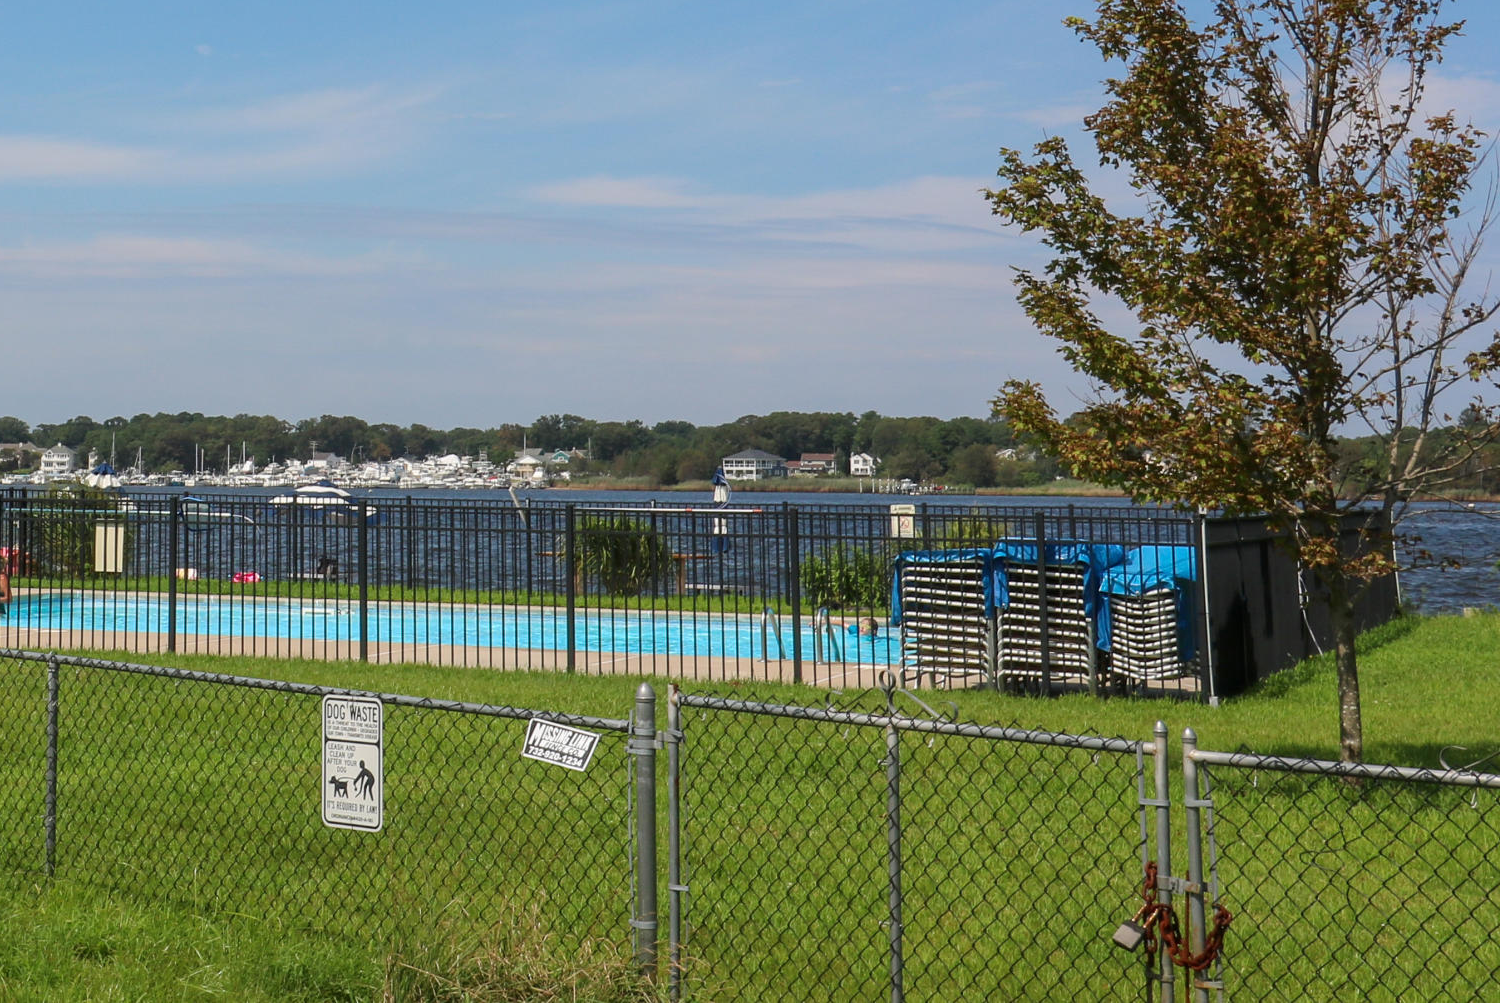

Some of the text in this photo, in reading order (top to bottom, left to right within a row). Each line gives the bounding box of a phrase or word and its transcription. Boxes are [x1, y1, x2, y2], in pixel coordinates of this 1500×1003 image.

[327, 703, 378, 723] DOG WASTE
[528, 722, 594, 751] MISSING LINK
[528, 745, 583, 767] 732-920-1234
[327, 800, 335, 809] IT'S
[336, 801, 357, 812] REQUIRED
[359, 804, 365, 812] BY
